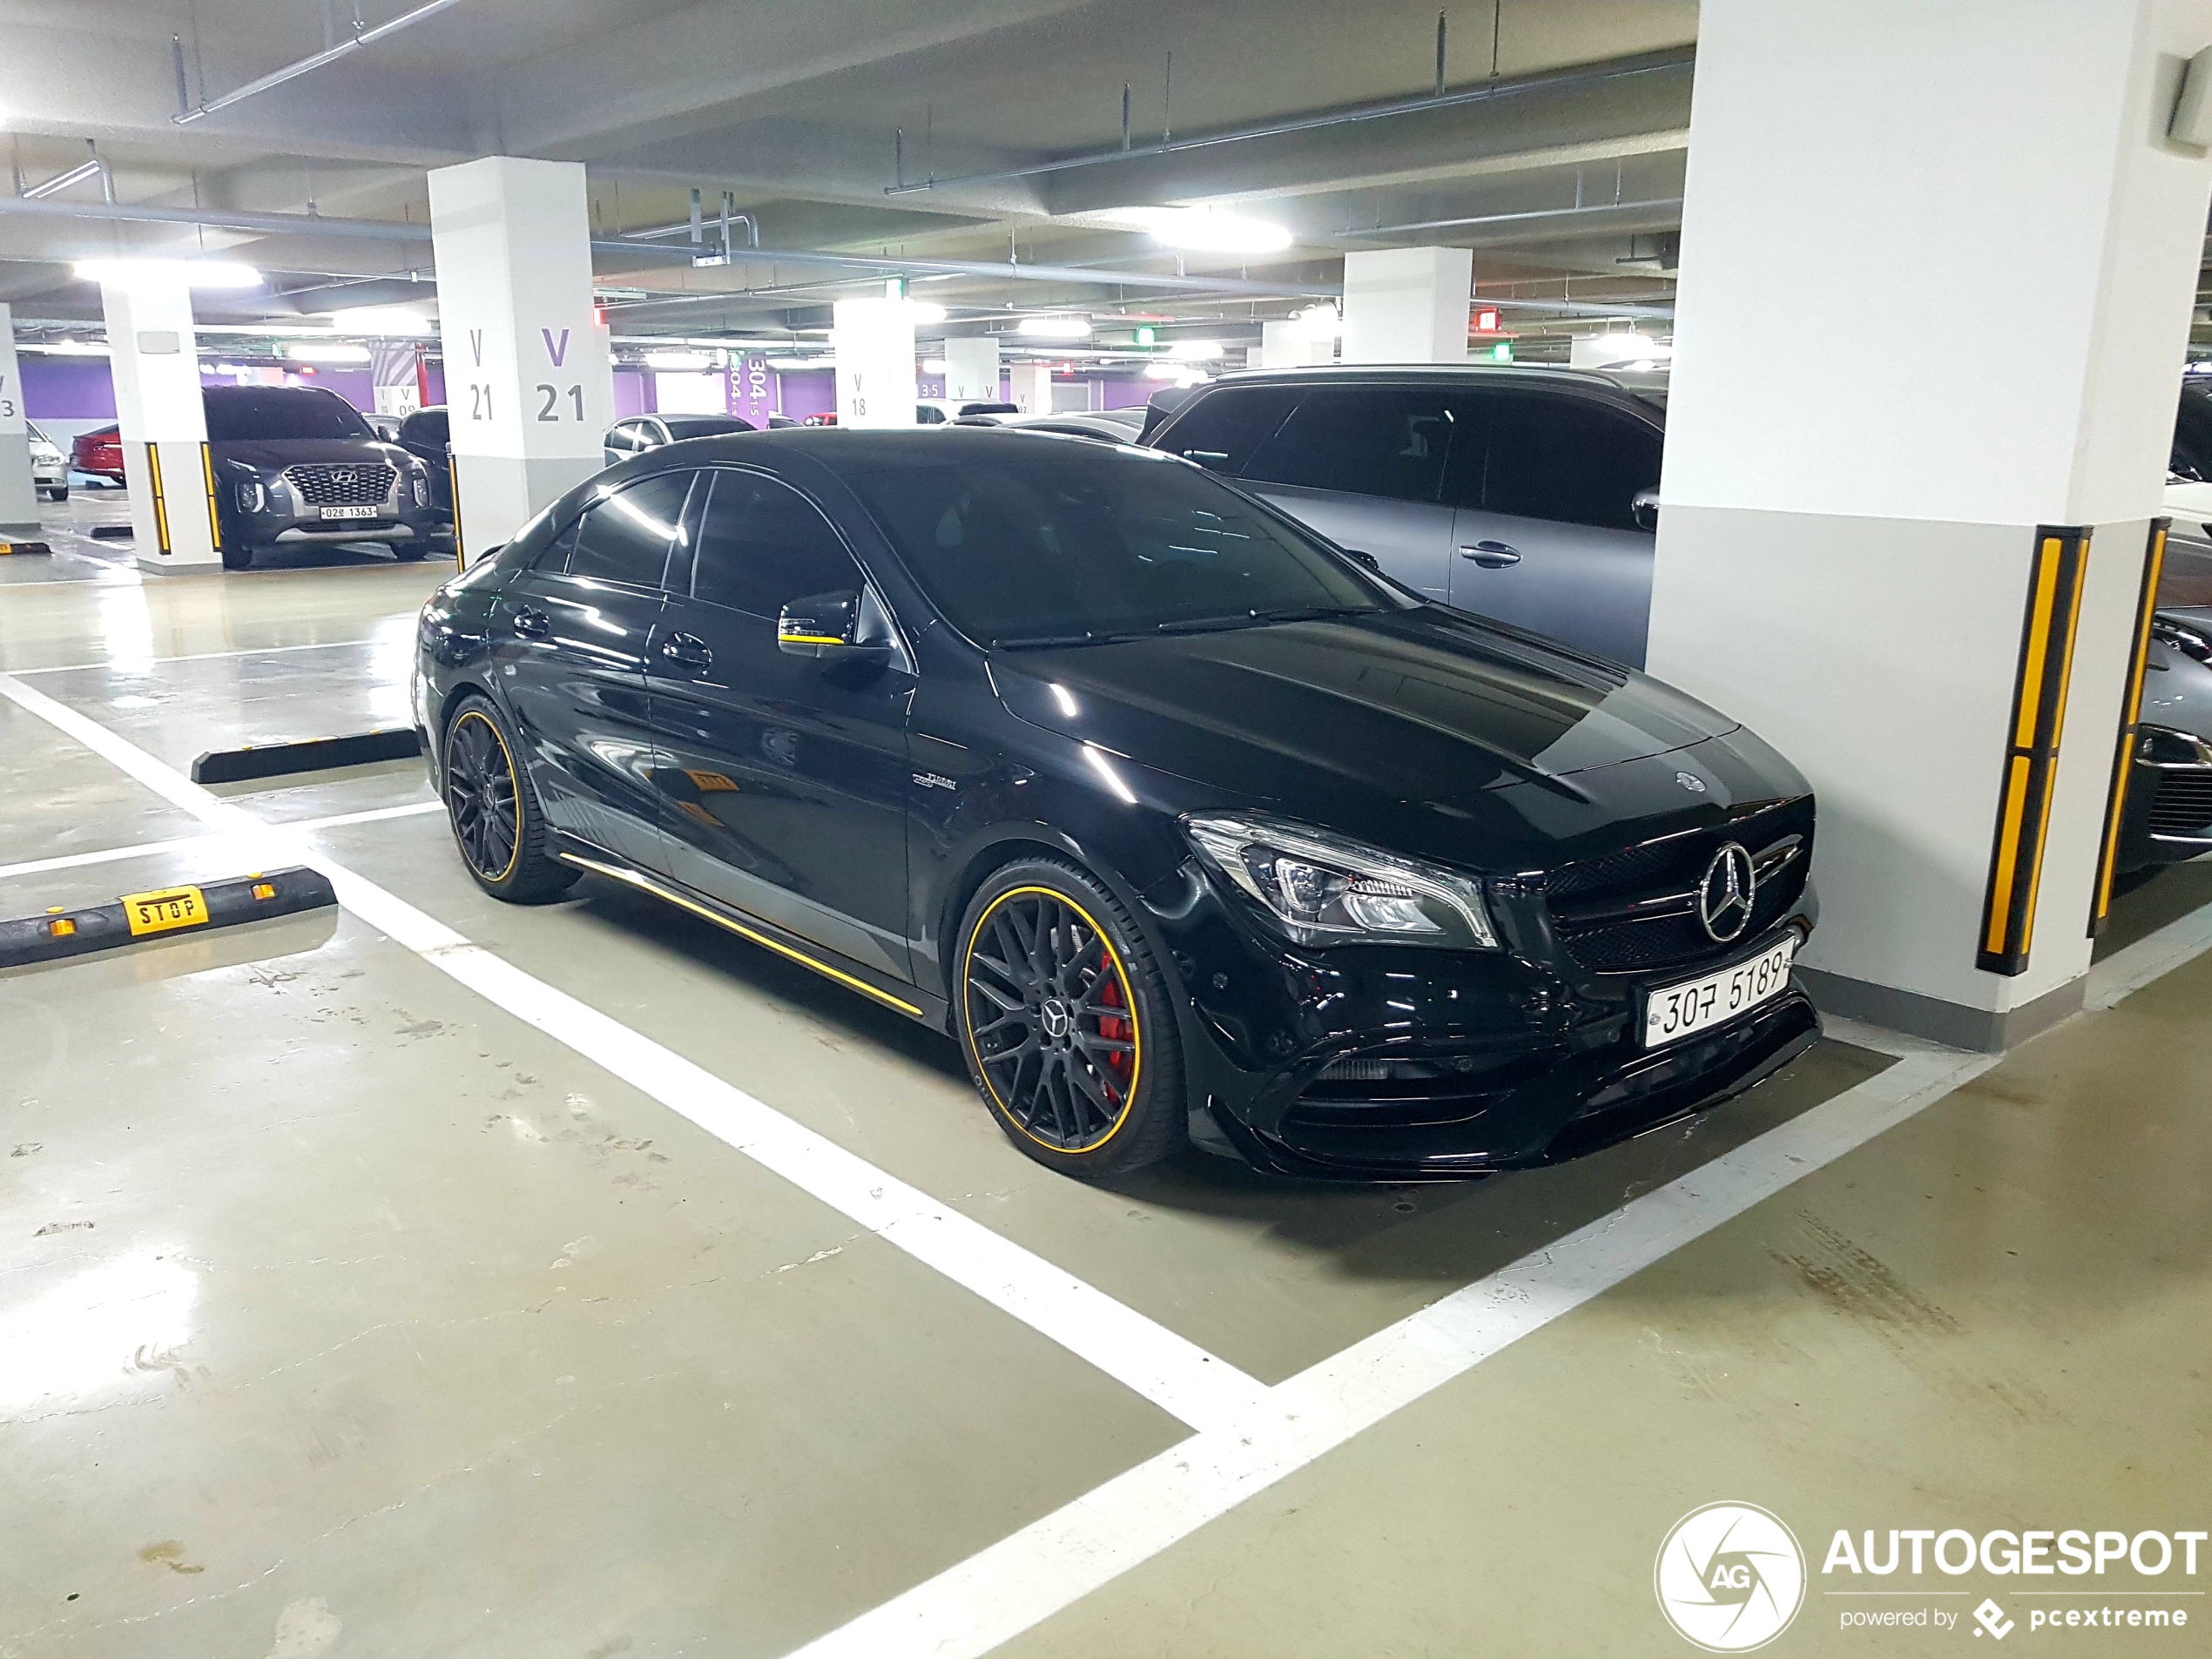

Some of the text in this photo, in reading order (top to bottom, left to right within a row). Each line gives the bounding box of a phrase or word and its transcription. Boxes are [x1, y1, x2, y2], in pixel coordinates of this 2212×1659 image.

[469, 328, 482, 367] V
[541, 327, 570, 368] V
[401, 388, 410, 401] V
[748, 358, 767, 400] 304
[853, 374, 862, 392] V
[985, 386, 993, 398] V
[470, 383, 493, 421] 21
[536, 383, 584, 421] 21
[852, 398, 866, 416] 18
[349, 507, 373, 517] 1363
[138, 900, 194, 925] STOP
[1663, 951, 1784, 1034] 30구 5189
